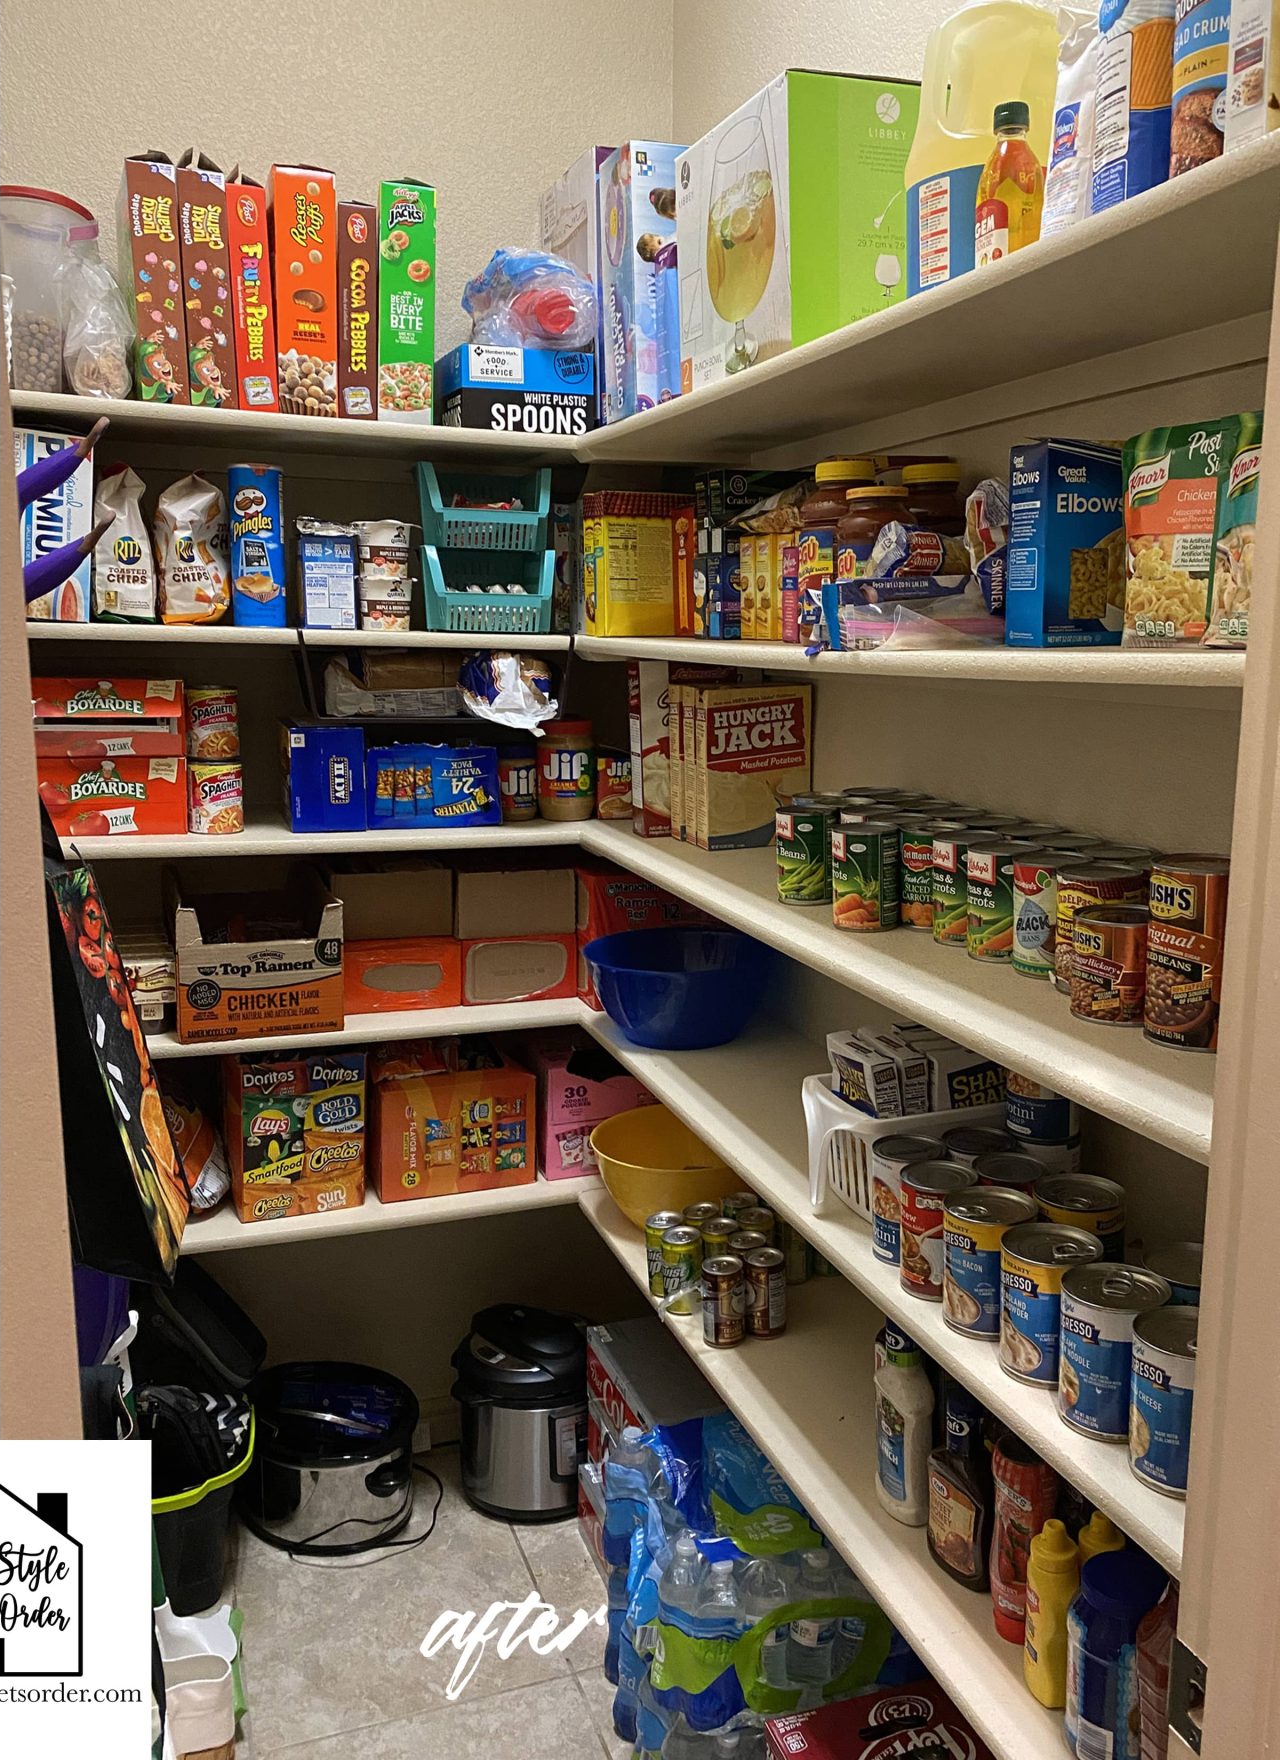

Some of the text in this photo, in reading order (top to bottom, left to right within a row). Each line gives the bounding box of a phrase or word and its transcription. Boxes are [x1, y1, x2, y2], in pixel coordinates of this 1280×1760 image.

[1183, 59, 1208, 76] PLAIN
[868, 127, 906, 141] LIBBEY
[130, 193, 143, 237] Chocolate
[141, 197, 159, 235] Lucky
[239, 198, 254, 223] Post
[157, 196, 175, 242] Charms
[180, 202, 193, 245] Chocolate
[192, 205, 208, 243] Lucky
[207, 204, 224, 250] Charms
[290, 193, 307, 247] Reese's
[307, 202, 324, 244] Puffs
[388, 209, 424, 229] JACKS
[240, 242, 268, 362] FRUITY PEBBLES
[390, 295, 423, 306] BEST IN
[349, 257, 370, 372] COCOA PEBBLES
[390, 305, 421, 316] EVERY
[390, 316, 423, 330] BITE
[486, 357, 507, 366] FOOD
[557, 356, 579, 368] STRONG
[480, 368, 513, 377] SERVICE
[561, 365, 586, 378] DURABLE
[524, 393, 587, 406] WHITE PLASTIC
[491, 403, 588, 434] SPOONS
[1012, 470, 1040, 487] Elbows
[1058, 465, 1087, 477] Great
[1065, 475, 1087, 484] Value
[1129, 468, 1166, 491] Knorr
[727, 496, 758, 505] Cracker
[1177, 489, 1217, 502] Chicken
[233, 517, 272, 541] Pringles
[114, 539, 141, 560] RITZ
[107, 574, 147, 584] CHIPS
[108, 567, 147, 575] TOASTED
[173, 572, 209, 583] CHIPS
[991, 559, 1003, 610] SKINNER
[74, 690, 96, 699] Chef
[67, 699, 144, 715] BOYARDEE
[713, 704, 794, 727] HUNGRY
[711, 719, 797, 755] JACK
[108, 742, 131, 751] 12 CANS
[451, 760, 472, 769] PACK
[543, 751, 589, 780] Jif
[740, 756, 802, 770] Mashed Potatoes
[78, 772, 98, 784] Chef
[442, 768, 482, 777] VARIETY
[70, 782, 146, 800] BOYARDEE
[451, 778, 475, 794] 24
[434, 801, 477, 817] PLANTERS
[110, 814, 133, 827] 12 CANS
[780, 847, 806, 860] Beans
[905, 885, 931, 894] SLICED
[1016, 915, 1050, 931] BLACK
[325, 942, 338, 955] 48
[219, 960, 314, 977] Top Ramen
[1088, 958, 1116, 974] Hickory
[1157, 957, 1192, 971] BEANS
[1083, 972, 1104, 985] BEANS
[192, 989, 216, 1000] ADDED
[198, 996, 214, 1005] MSG
[227, 990, 319, 1012] CHICKEN FLAVOR
[228, 1013, 241, 1022] WITH
[242, 1010, 263, 1021] NATURAL
[275, 1009, 298, 1018] ARTIFICIAL
[299, 1008, 319, 1016] FLAVORS
[243, 1069, 295, 1087] Doritos
[313, 1066, 359, 1081] Doritos
[564, 1086, 588, 1099] 30
[321, 1097, 354, 1111] ROLD
[561, 1101, 591, 1109] POUCHES
[319, 1105, 357, 1125] GOLD
[253, 1117, 289, 1135] Lay's
[334, 1122, 358, 1133] twists
[310, 1142, 361, 1171] Cheetos
[246, 1157, 303, 1183] Smartfood
[407, 1173, 417, 1185] 28
[254, 1195, 293, 1218] Cheetos
[317, 1188, 346, 1211] Sun
[962, 1258, 983, 1273] BACON
[1138, 1390, 1162, 1413] CHEESE
[762, 1512, 794, 1534] 40
